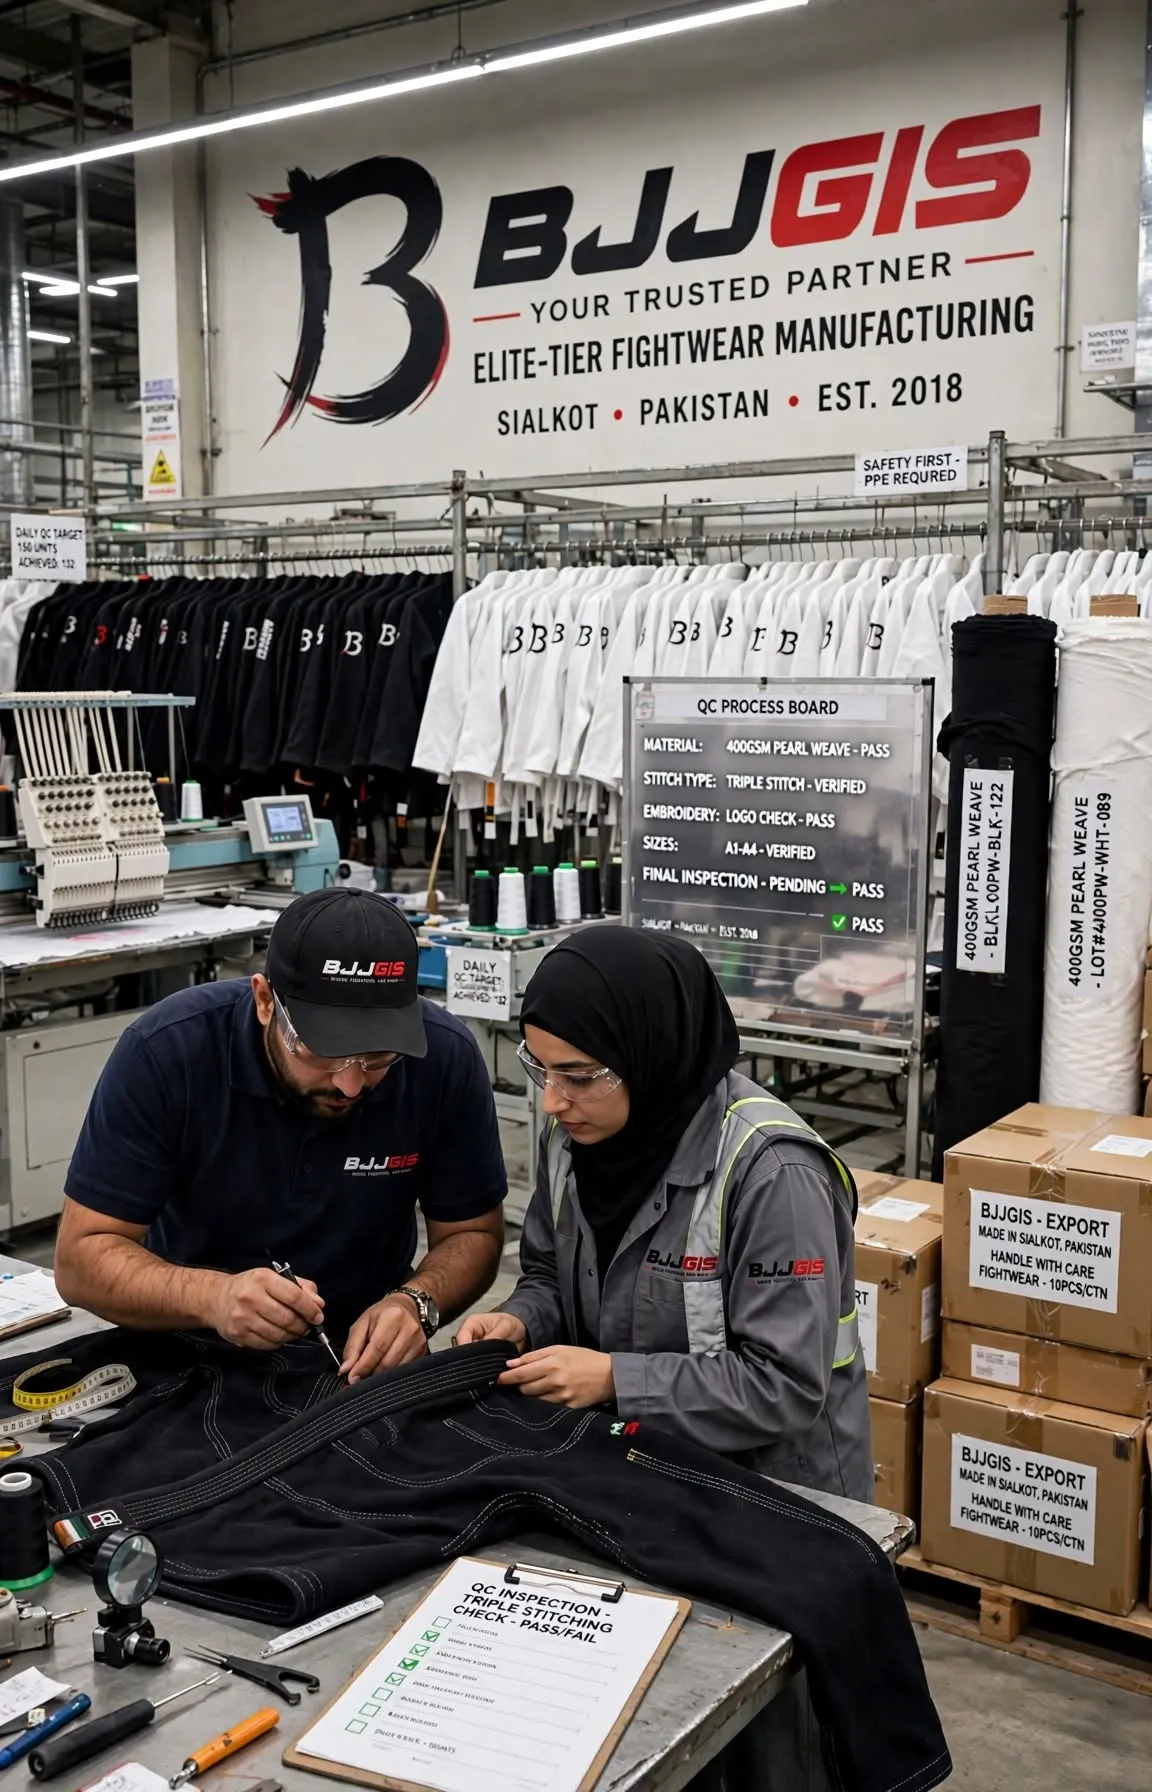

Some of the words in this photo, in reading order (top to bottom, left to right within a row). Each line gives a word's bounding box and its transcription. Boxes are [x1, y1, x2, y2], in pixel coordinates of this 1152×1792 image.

[473, 104, 1041, 289] BJJGIS
[530, 294, 610, 324] YOUR
[624, 274, 770, 313] TRUSTED
[787, 251, 952, 295] PARTNER
[474, 340, 602, 384] ELITE-TIER
[612, 323, 764, 370] FIGHTWEAR
[775, 294, 1035, 356] MANUFACTURING
[497, 403, 599, 436] SIALKOT
[640, 388, 769, 426] PAKISTAN
[818, 381, 877, 412] EST.
[891, 372, 963, 407] 2018
[863, 456, 911, 471] SAFETY
[915, 453, 952, 467] FIRST
[865, 474, 889, 486] PPE
[893, 469, 957, 485] REQURED
[527, 623, 548, 653] B
[668, 620, 688, 645] B
[777, 628, 798, 655] B
[697, 699, 717, 714] QC
[721, 699, 784, 714] PROCESS
[788, 700, 839, 715] BOARD
[644, 737, 703, 753] MATERIAL:
[726, 740, 771, 755] 400GSM
[773, 741, 808, 756] PEARL
[810, 742, 851, 757] WEAVE
[860, 743, 890, 758] PASS
[643, 771, 682, 786] STITCH
[684, 773, 717, 788] TYPE:
[726, 774, 763, 790] TRIPLE
[765, 776, 805, 791] STITCH
[814, 778, 866, 794] VERIFIED
[643, 803, 720, 822] EMBROIDERY:
[726, 808, 757, 824] LOGO
[759, 810, 797, 826] CHECK
[805, 813, 835, 828] PASS
[968, 781, 984, 837] WEAVE
[1073, 796, 1089, 856] WEAVE
[642, 835, 679, 852] SIZES:
[725, 841, 758, 856] A1-A4
[766, 844, 816, 860] VERIFIED
[642, 866, 679, 883] FINAL
[681, 869, 758, 890] INSPECTION
[769, 876, 827, 894] PENDING
[852, 882, 885, 899] PASS
[966, 841, 980, 893] PEARL
[1070, 861, 1086, 914] PEARL
[852, 917, 884, 933] PASS
[964, 898, 980, 961] 400GSM
[322, 959, 405, 977] BJJGIS
[463, 960, 497, 973] DAILY
[1068, 919, 1084, 987] 400GSM
[344, 1152, 419, 1170] BJJGIS
[981, 1202, 1033, 1226] BJJGIS
[1046, 1212, 1110, 1238] EXPORT
[978, 1225, 1005, 1241] MADE
[1007, 1230, 1017, 1243] IN
[1065, 1240, 1112, 1259] PAKISTAN
[646, 1249, 718, 1271] BJJGIS
[748, 1259, 825, 1278] BJJGIS
[991, 1249, 1033, 1268] HANDLE
[1036, 1257, 1062, 1273] WITH
[1065, 1263, 1095, 1279] CARE
[979, 1264, 1040, 1287] FIGHTWEAR
[1050, 1278, 1108, 1300] 10PCS/CTN
[962, 1446, 1011, 1472] BJJGIS
[1025, 1462, 1086, 1491] EXPORT
[959, 1467, 985, 1485] MADE
[987, 1475, 997, 1488] IN
[1042, 1489, 1088, 1511] PAKISTAN
[960, 1506, 1019, 1534] FIGHTWEAR
[1028, 1525, 1085, 1551] 10PCS/CTN
[971, 1492, 1012, 1515] HANDLE
[1014, 1503, 1040, 1522] WITH
[1043, 1512, 1072, 1531] CARE
[463, 1593, 520, 1614] TRIPLE
[522, 1606, 613, 1634] STITCHING
[471, 1582, 496, 1595] QC
[498, 1588, 601, 1617] INSPECTION
[453, 1605, 509, 1624] CHECK
[519, 1619, 598, 1645] PASS/FAIL
